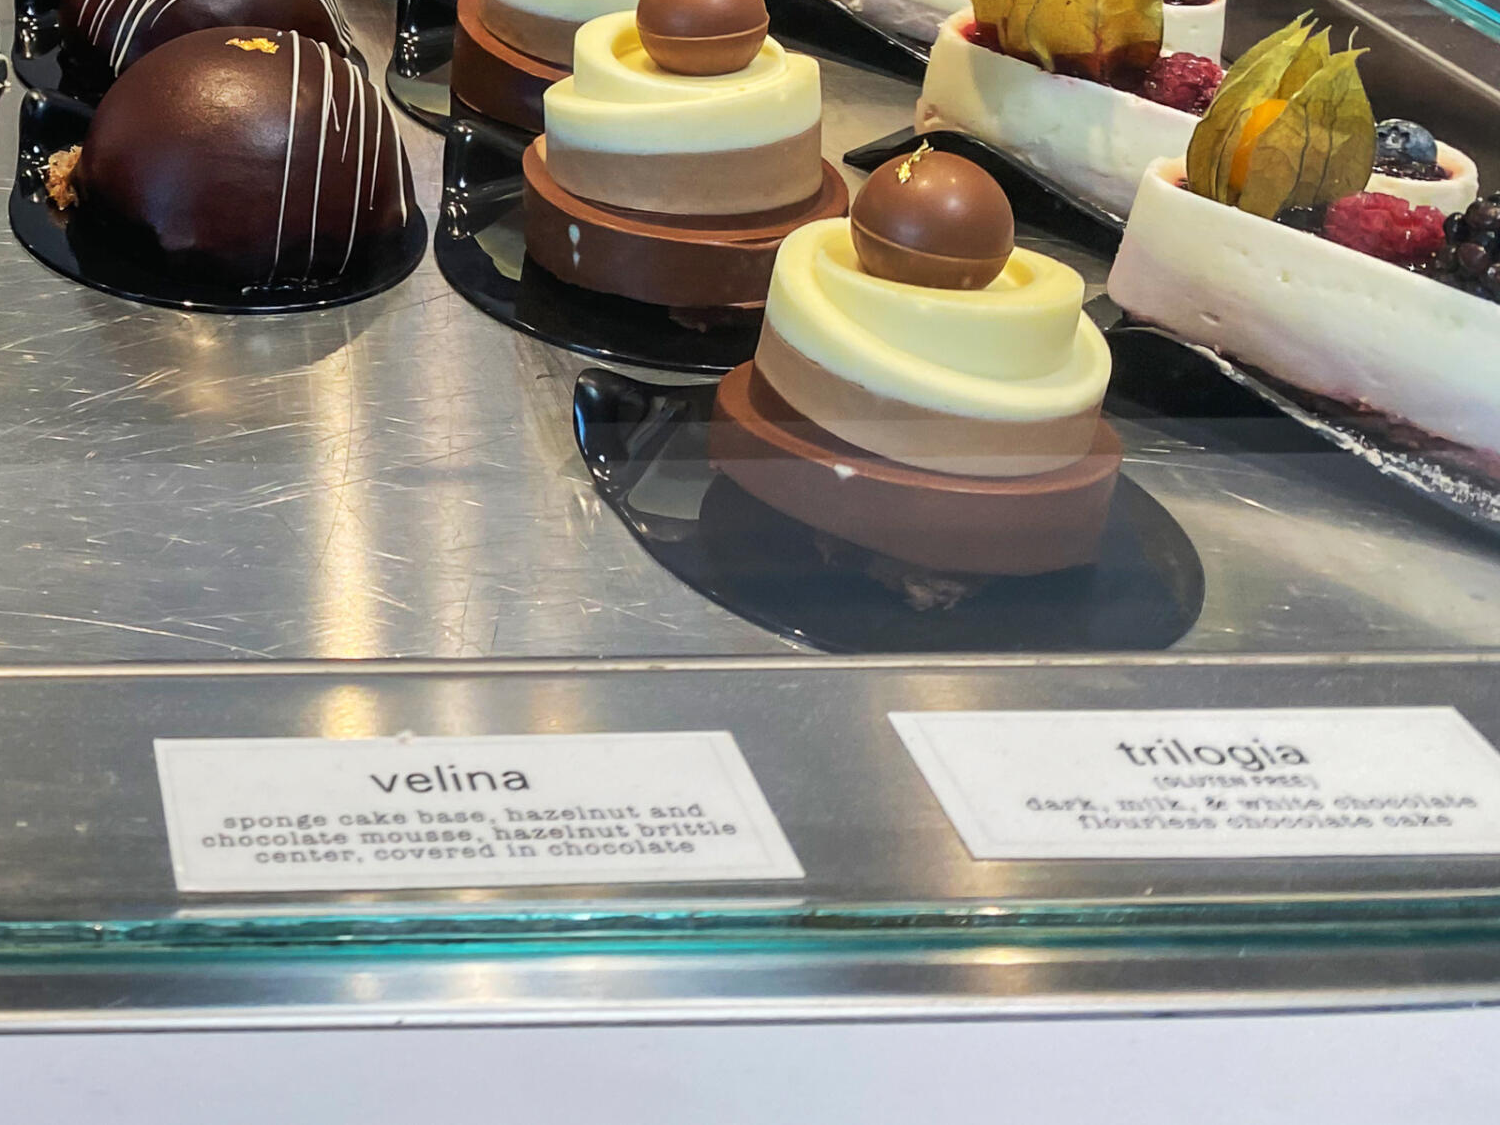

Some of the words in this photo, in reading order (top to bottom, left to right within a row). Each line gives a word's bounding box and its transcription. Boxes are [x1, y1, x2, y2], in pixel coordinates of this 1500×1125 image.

[1116, 738, 1310, 773] trilogia
[369, 764, 530, 794] velina
[1203, 795, 1226, 811] &
[1236, 795, 1325, 811] white
[1333, 794, 1478, 810] chocolate
[222, 813, 328, 831] sponge
[338, 810, 408, 826] cake
[416, 809, 497, 825] base,
[504, 805, 640, 823] hazelnut
[650, 803, 708, 819] and
[1226, 813, 1374, 830] chocolate
[1382, 813, 1454, 827] cake
[201, 830, 349, 849] chocolate
[359, 827, 486, 845] mousse,
[493, 823, 630, 841] hazelnut
[638, 820, 738, 838] brittle
[254, 848, 364, 865] center,
[373, 844, 496, 862] covered
[506, 840, 538, 858] in
[547, 837, 696, 856] chocolate
